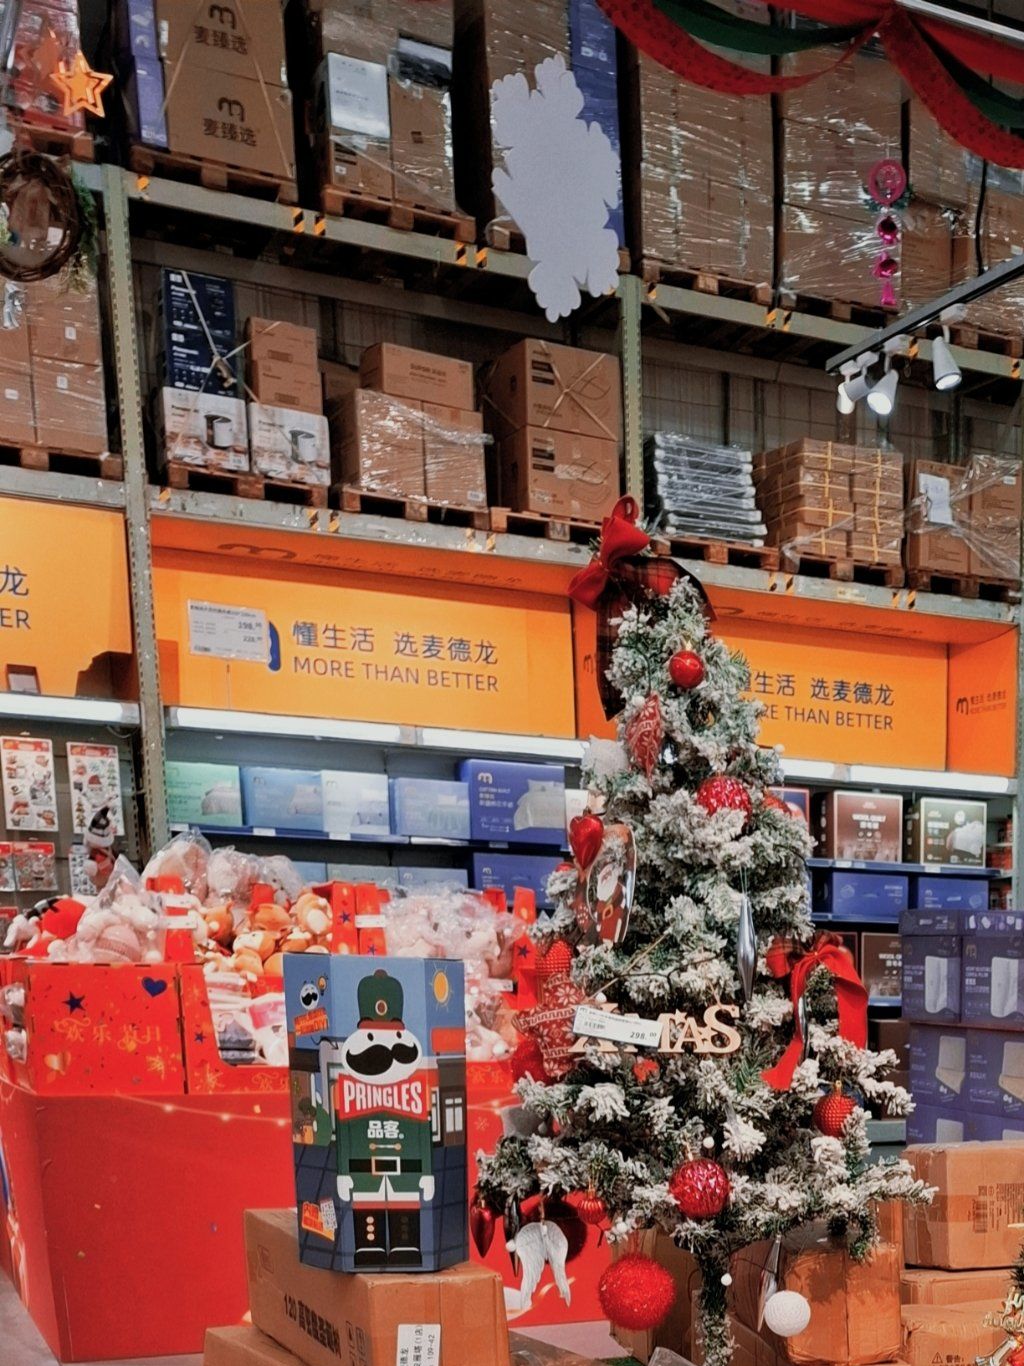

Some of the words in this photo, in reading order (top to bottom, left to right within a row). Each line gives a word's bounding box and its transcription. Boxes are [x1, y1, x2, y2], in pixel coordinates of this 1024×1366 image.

[194, 25, 249, 55] 麦臻选
[203, 118, 257, 146] 麦臻选
[292, 620, 375, 652] 懂生活
[394, 631, 499, 666] 选麦德龙
[293, 656, 355, 679] MORE
[362, 662, 420, 686] THAN
[427, 669, 499, 693] BETTER
[810, 677, 895, 707] 选麦德龙
[785, 706, 830, 726] THAN
[836, 711, 894, 731] BETTER
[343, 1079, 423, 1115] PRINGLES
[367, 1119, 401, 1140] 品客
